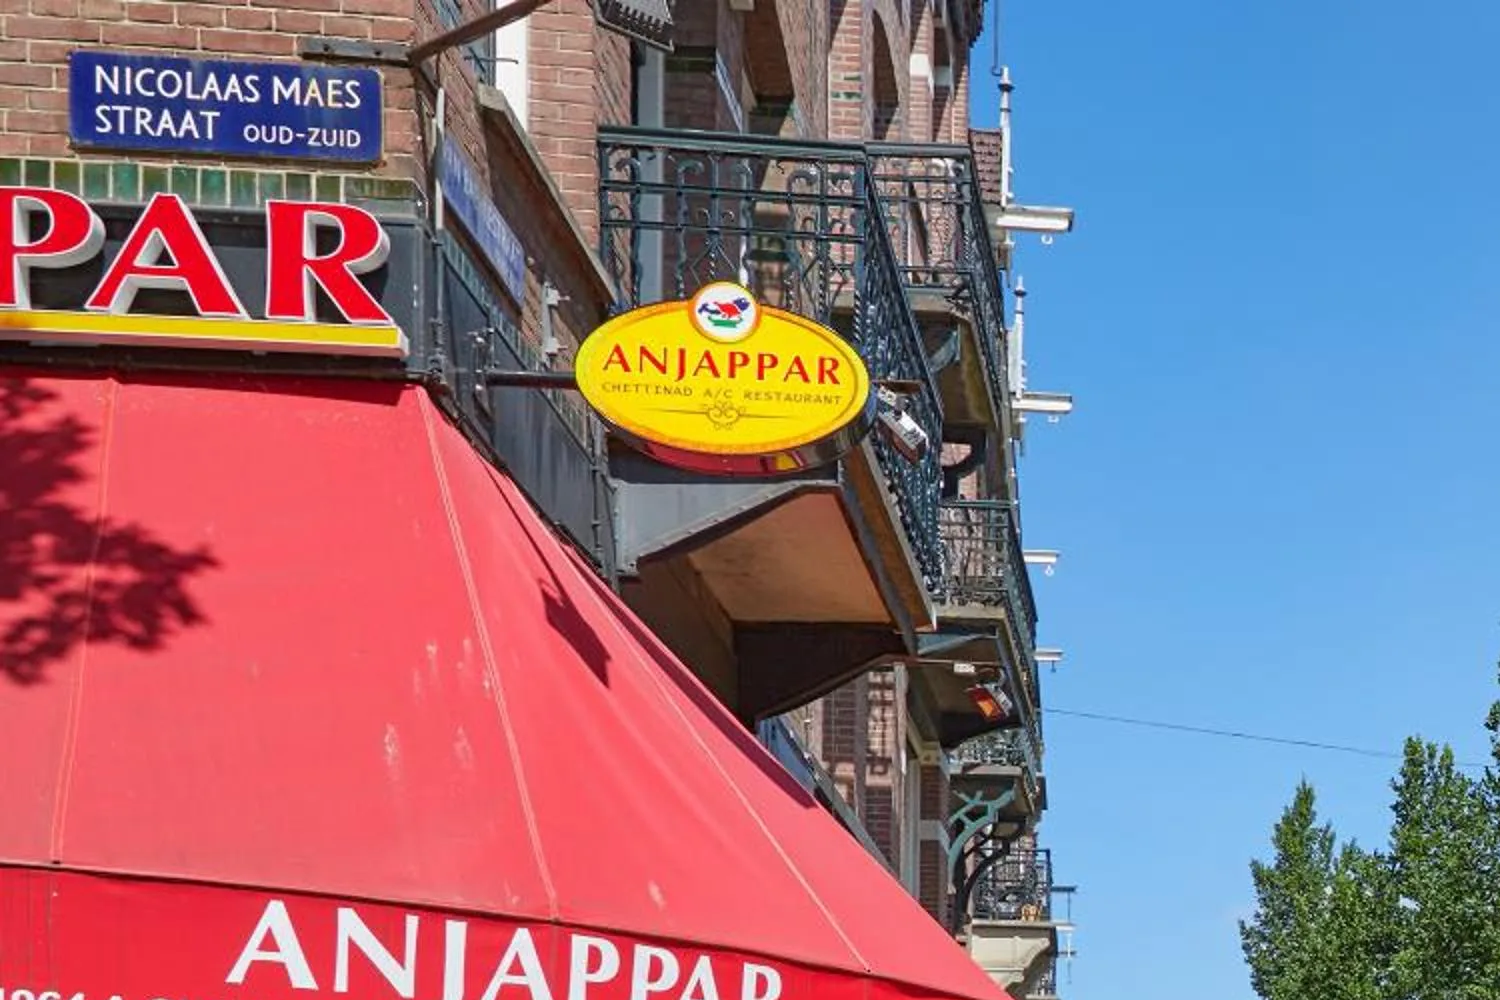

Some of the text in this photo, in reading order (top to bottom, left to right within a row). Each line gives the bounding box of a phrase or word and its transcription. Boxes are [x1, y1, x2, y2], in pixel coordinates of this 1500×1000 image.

[94, 65, 361, 108] NICOLAAS MAES
[94, 105, 361, 149] STRAAT OUD-ZUID
[0, 186, 393, 325] PAR
[602, 343, 841, 385] ANJAPPAR
[602, 382, 843, 406] CHETTINAD A/C RESTAURANT
